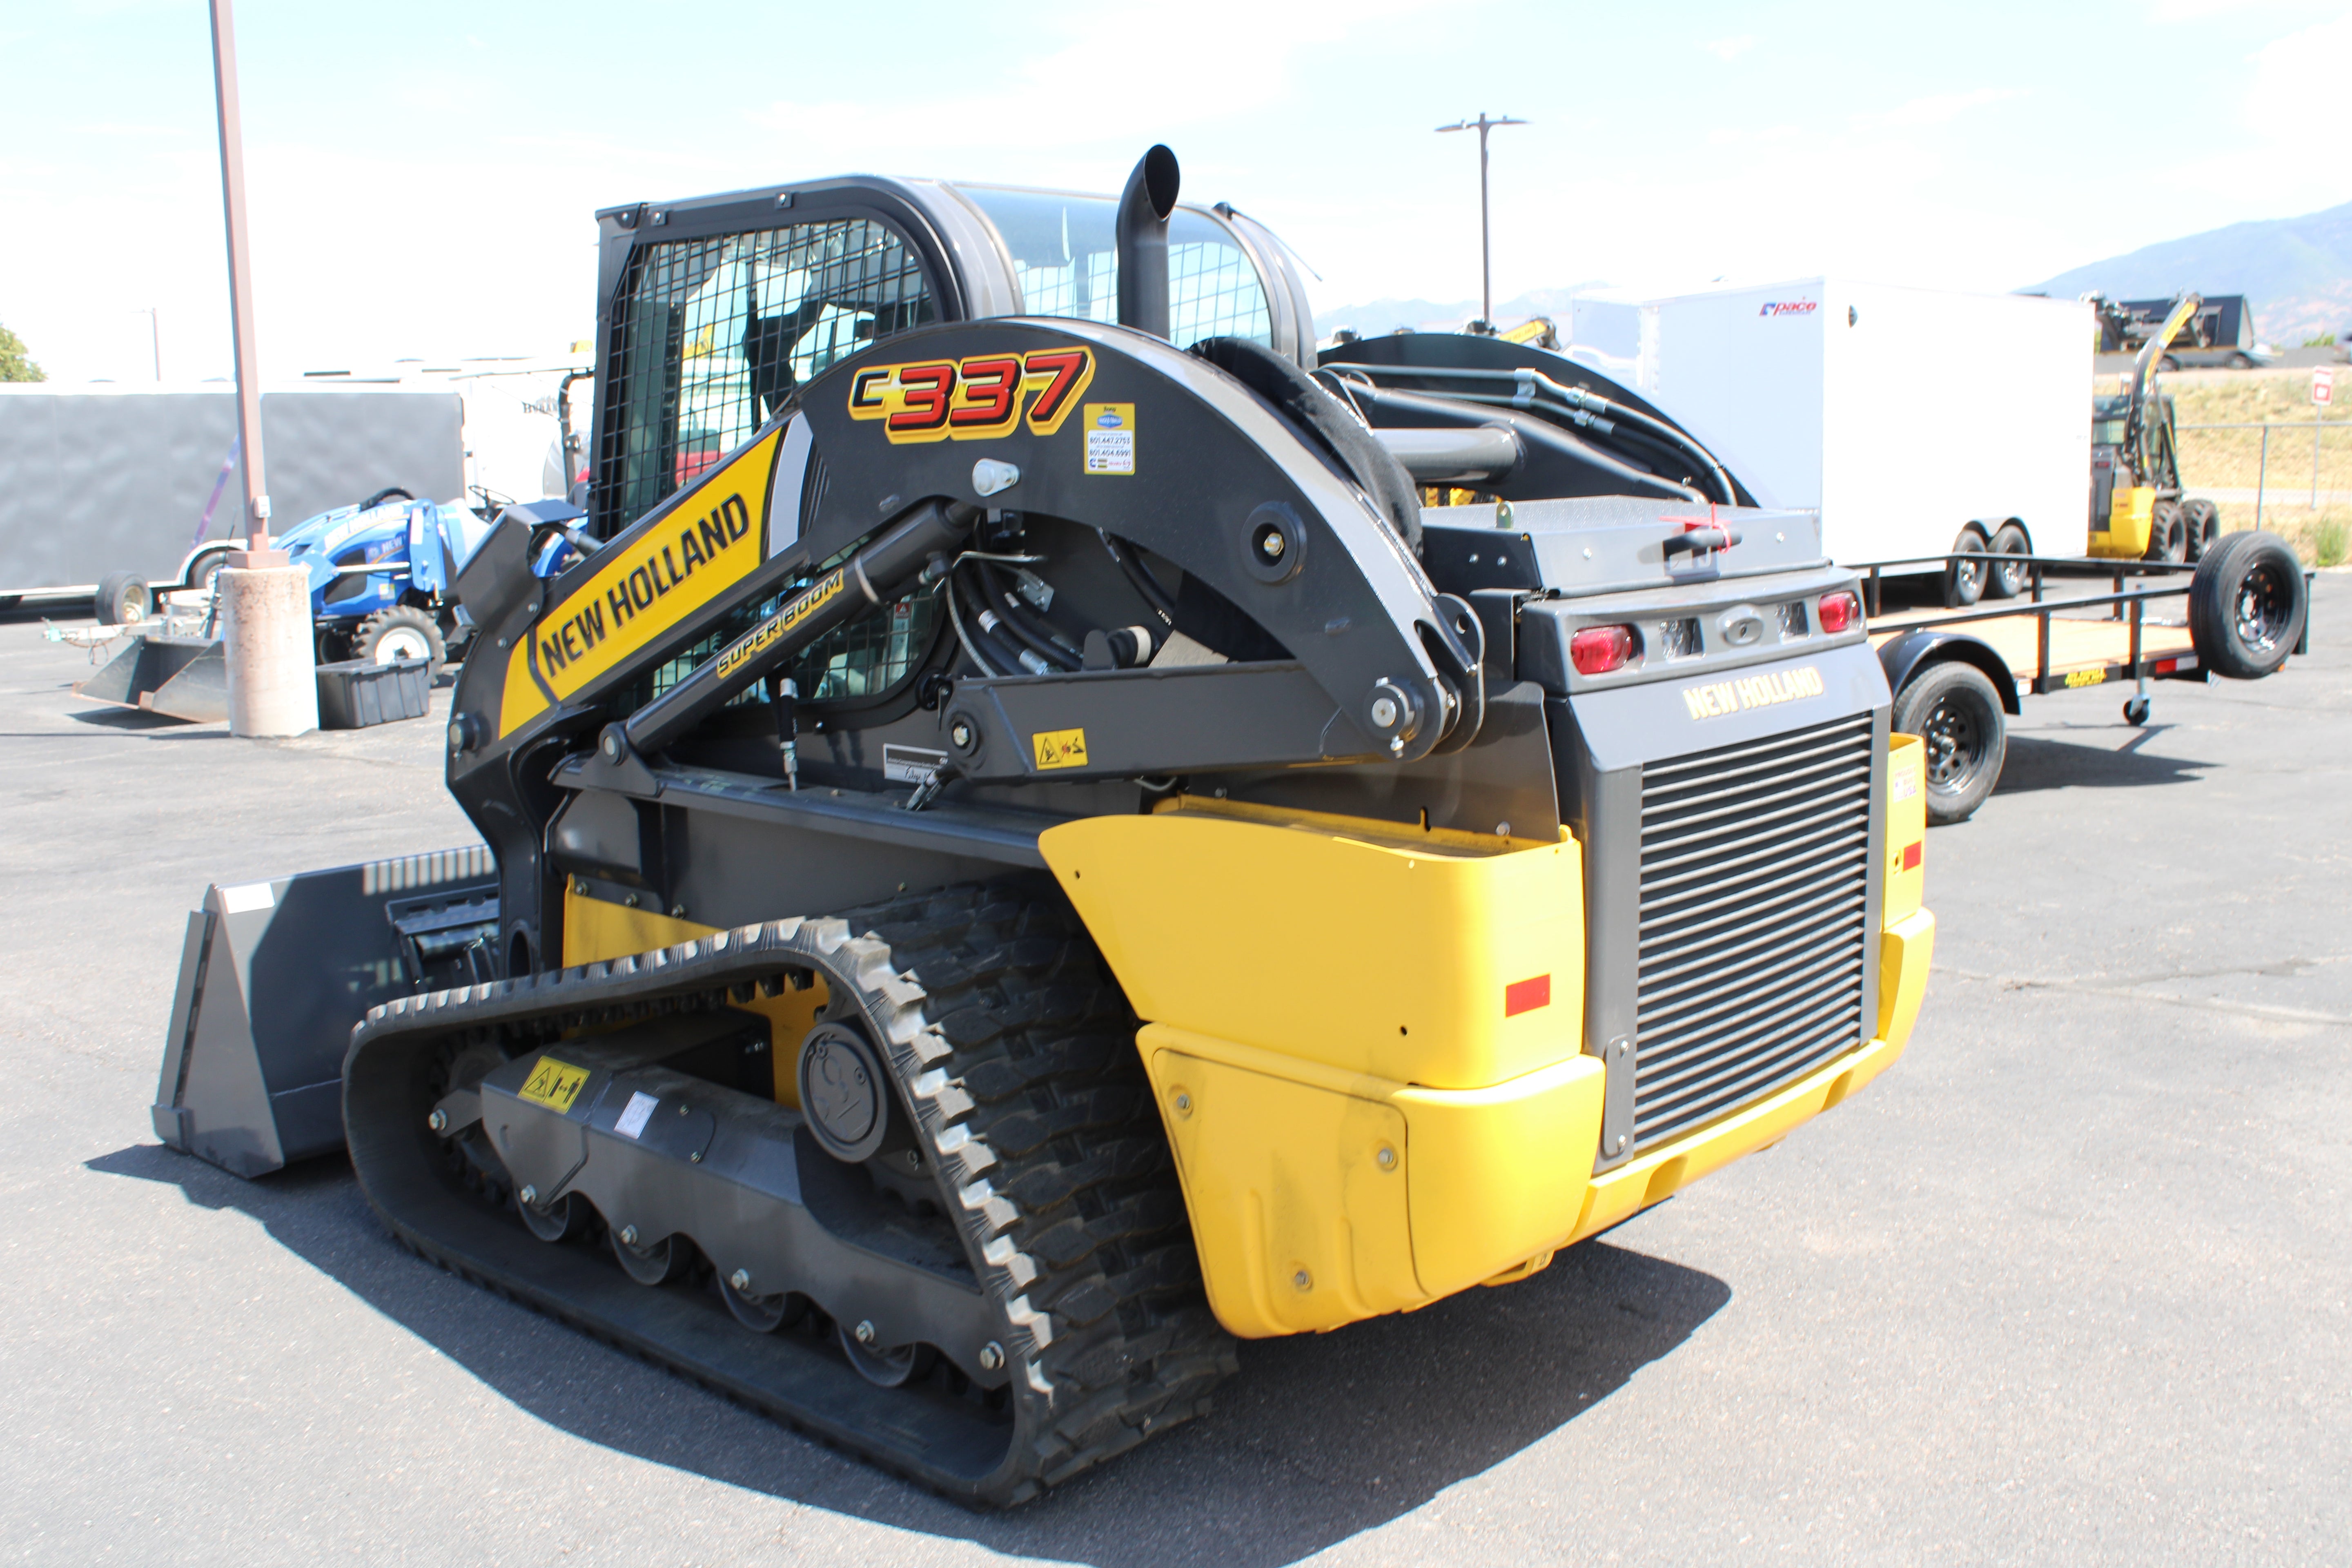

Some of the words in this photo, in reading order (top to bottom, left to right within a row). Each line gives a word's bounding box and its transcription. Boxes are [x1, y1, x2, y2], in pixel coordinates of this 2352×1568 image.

[349, 504, 404, 532] HOLLAND
[382, 536, 403, 552] NEW
[541, 598, 606, 677] NEW
[607, 493, 749, 628] HOLLAND
[1683, 682, 1739, 720] NEW
[1735, 666, 1823, 709] HOLLAND
